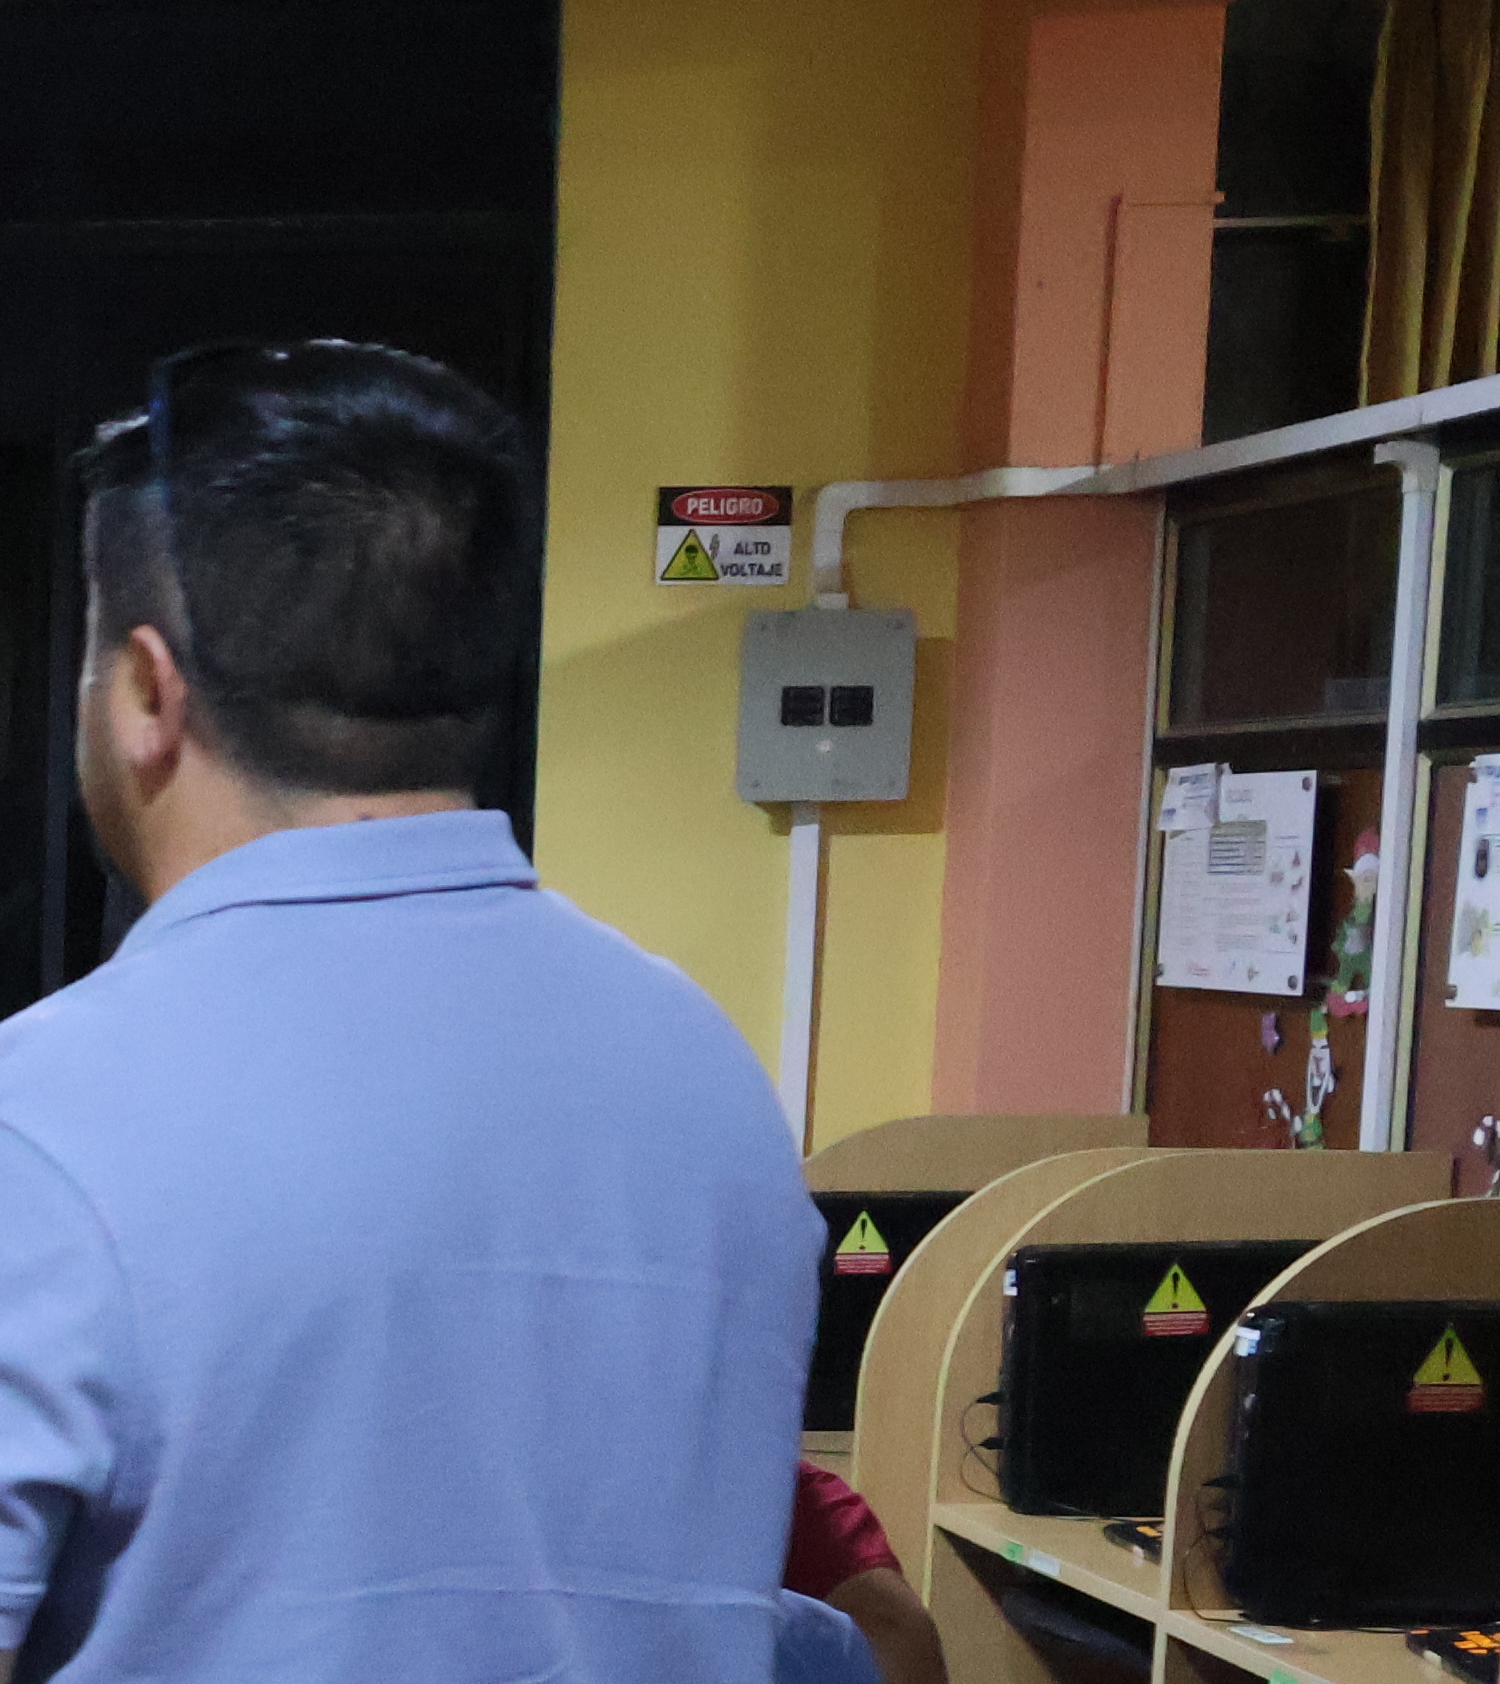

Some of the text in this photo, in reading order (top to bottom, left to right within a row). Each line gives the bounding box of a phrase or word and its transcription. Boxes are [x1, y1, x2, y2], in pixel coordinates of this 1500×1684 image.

[687, 498, 763, 516] PELIGRO
[733, 541, 771, 556] ALTO
[720, 562, 783, 577] VOLTAJE
